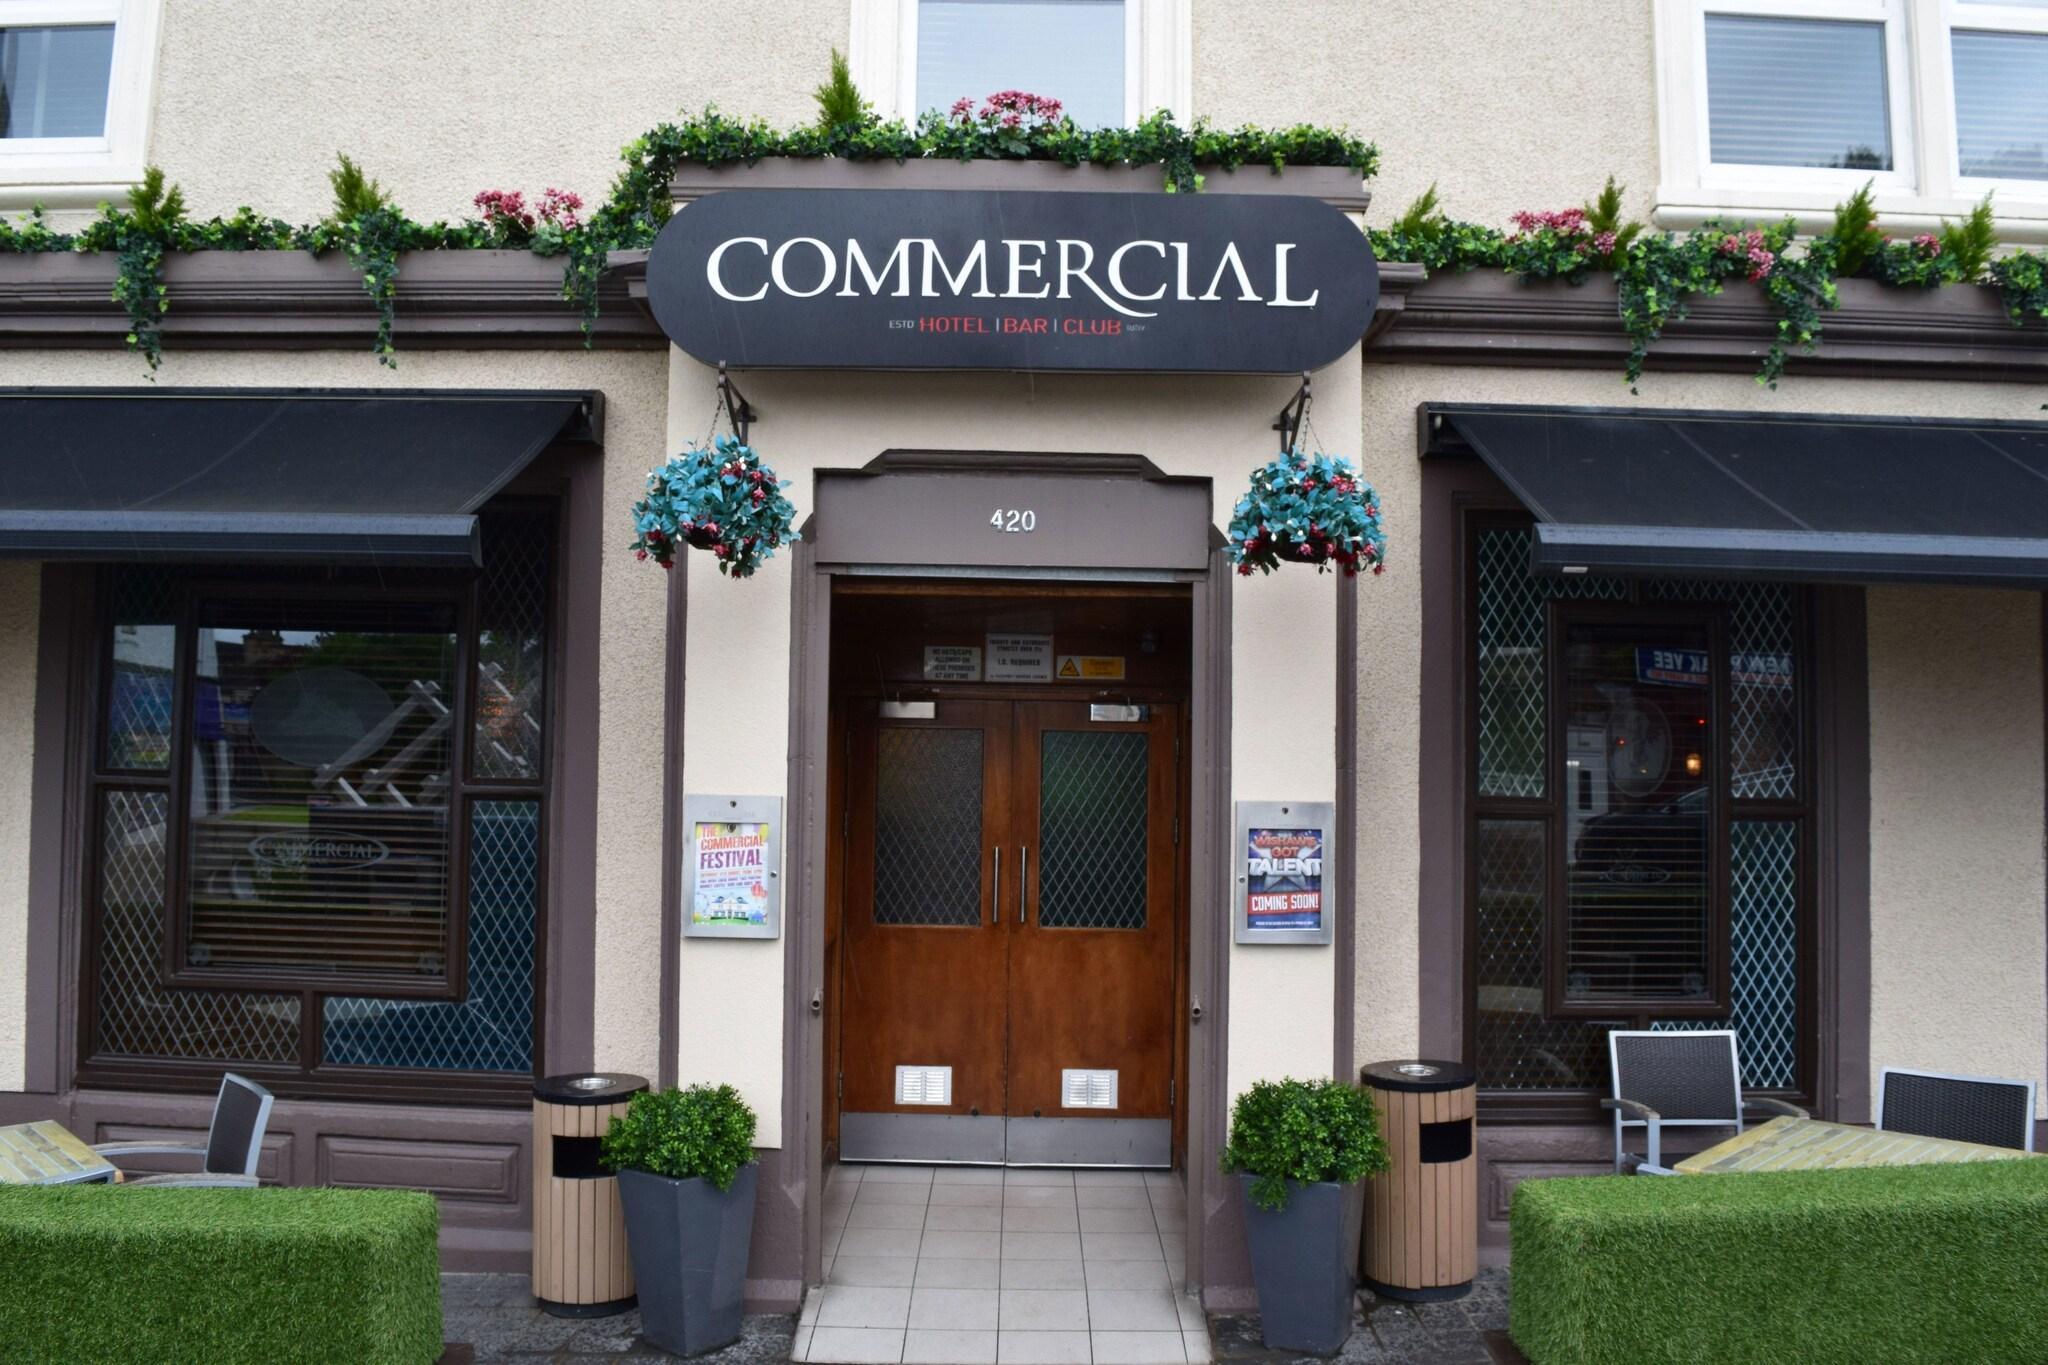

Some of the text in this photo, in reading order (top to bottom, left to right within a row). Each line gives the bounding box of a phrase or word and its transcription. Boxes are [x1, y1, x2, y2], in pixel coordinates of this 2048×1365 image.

[706, 236, 1320, 318] COMMERCIAL
[888, 319, 915, 330] ESTD
[918, 316, 990, 334] HOTEL
[1003, 317, 1048, 333] BAR
[1063, 319, 1122, 335] CLUB
[990, 509, 1036, 532] 420
[701, 834, 763, 850] COMMERCIAL
[700, 849, 762, 869] FESTIVAL
[1271, 846, 1300, 858] GOT
[1248, 858, 1322, 877] TALENT
[1251, 894, 1319, 911] COMING SOON!
